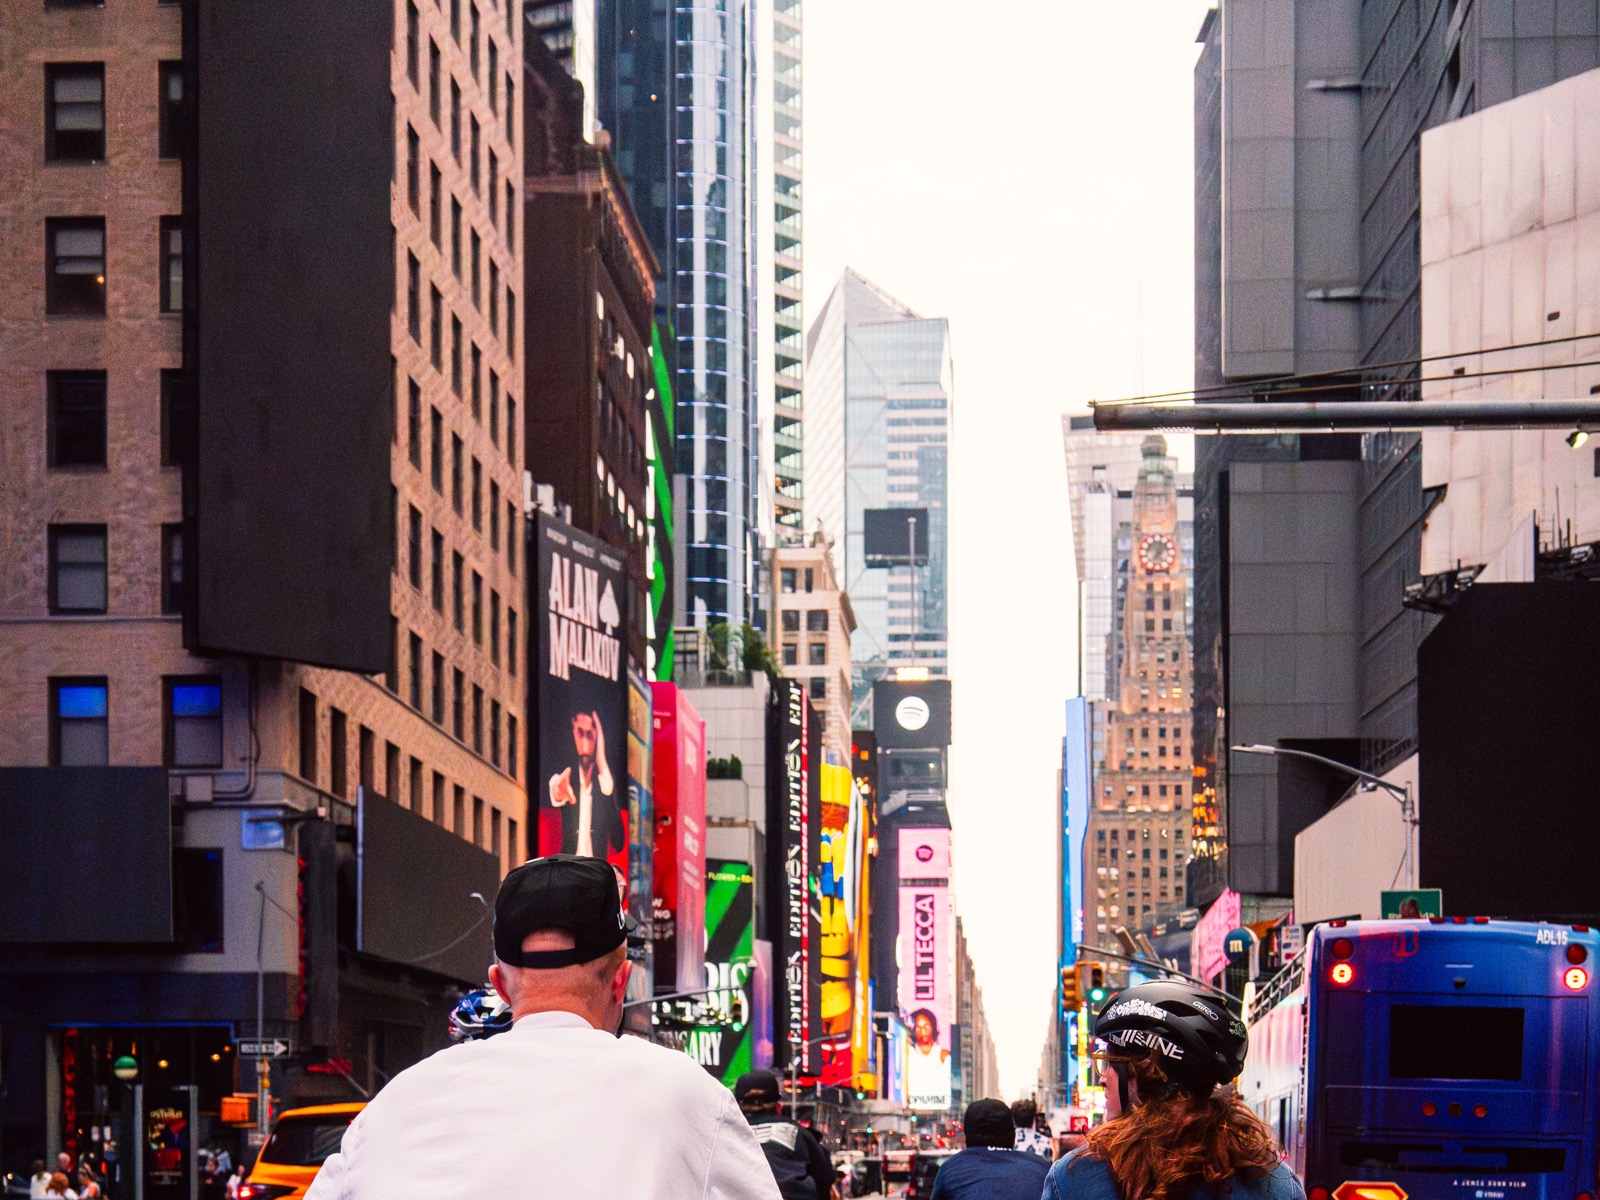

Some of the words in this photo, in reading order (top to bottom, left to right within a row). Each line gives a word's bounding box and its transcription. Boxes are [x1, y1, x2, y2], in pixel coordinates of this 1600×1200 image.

[549, 551, 599, 630] ALAN
[549, 611, 620, 682] MALAKOV
[787, 738, 802, 832] EDITION
[787, 844, 802, 938] EDITION
[916, 896, 934, 967] TECCA
[1229, 940, 1243, 953] m
[916, 968, 934, 999] LIL
[1192, 1001, 1219, 1020] GIRO
